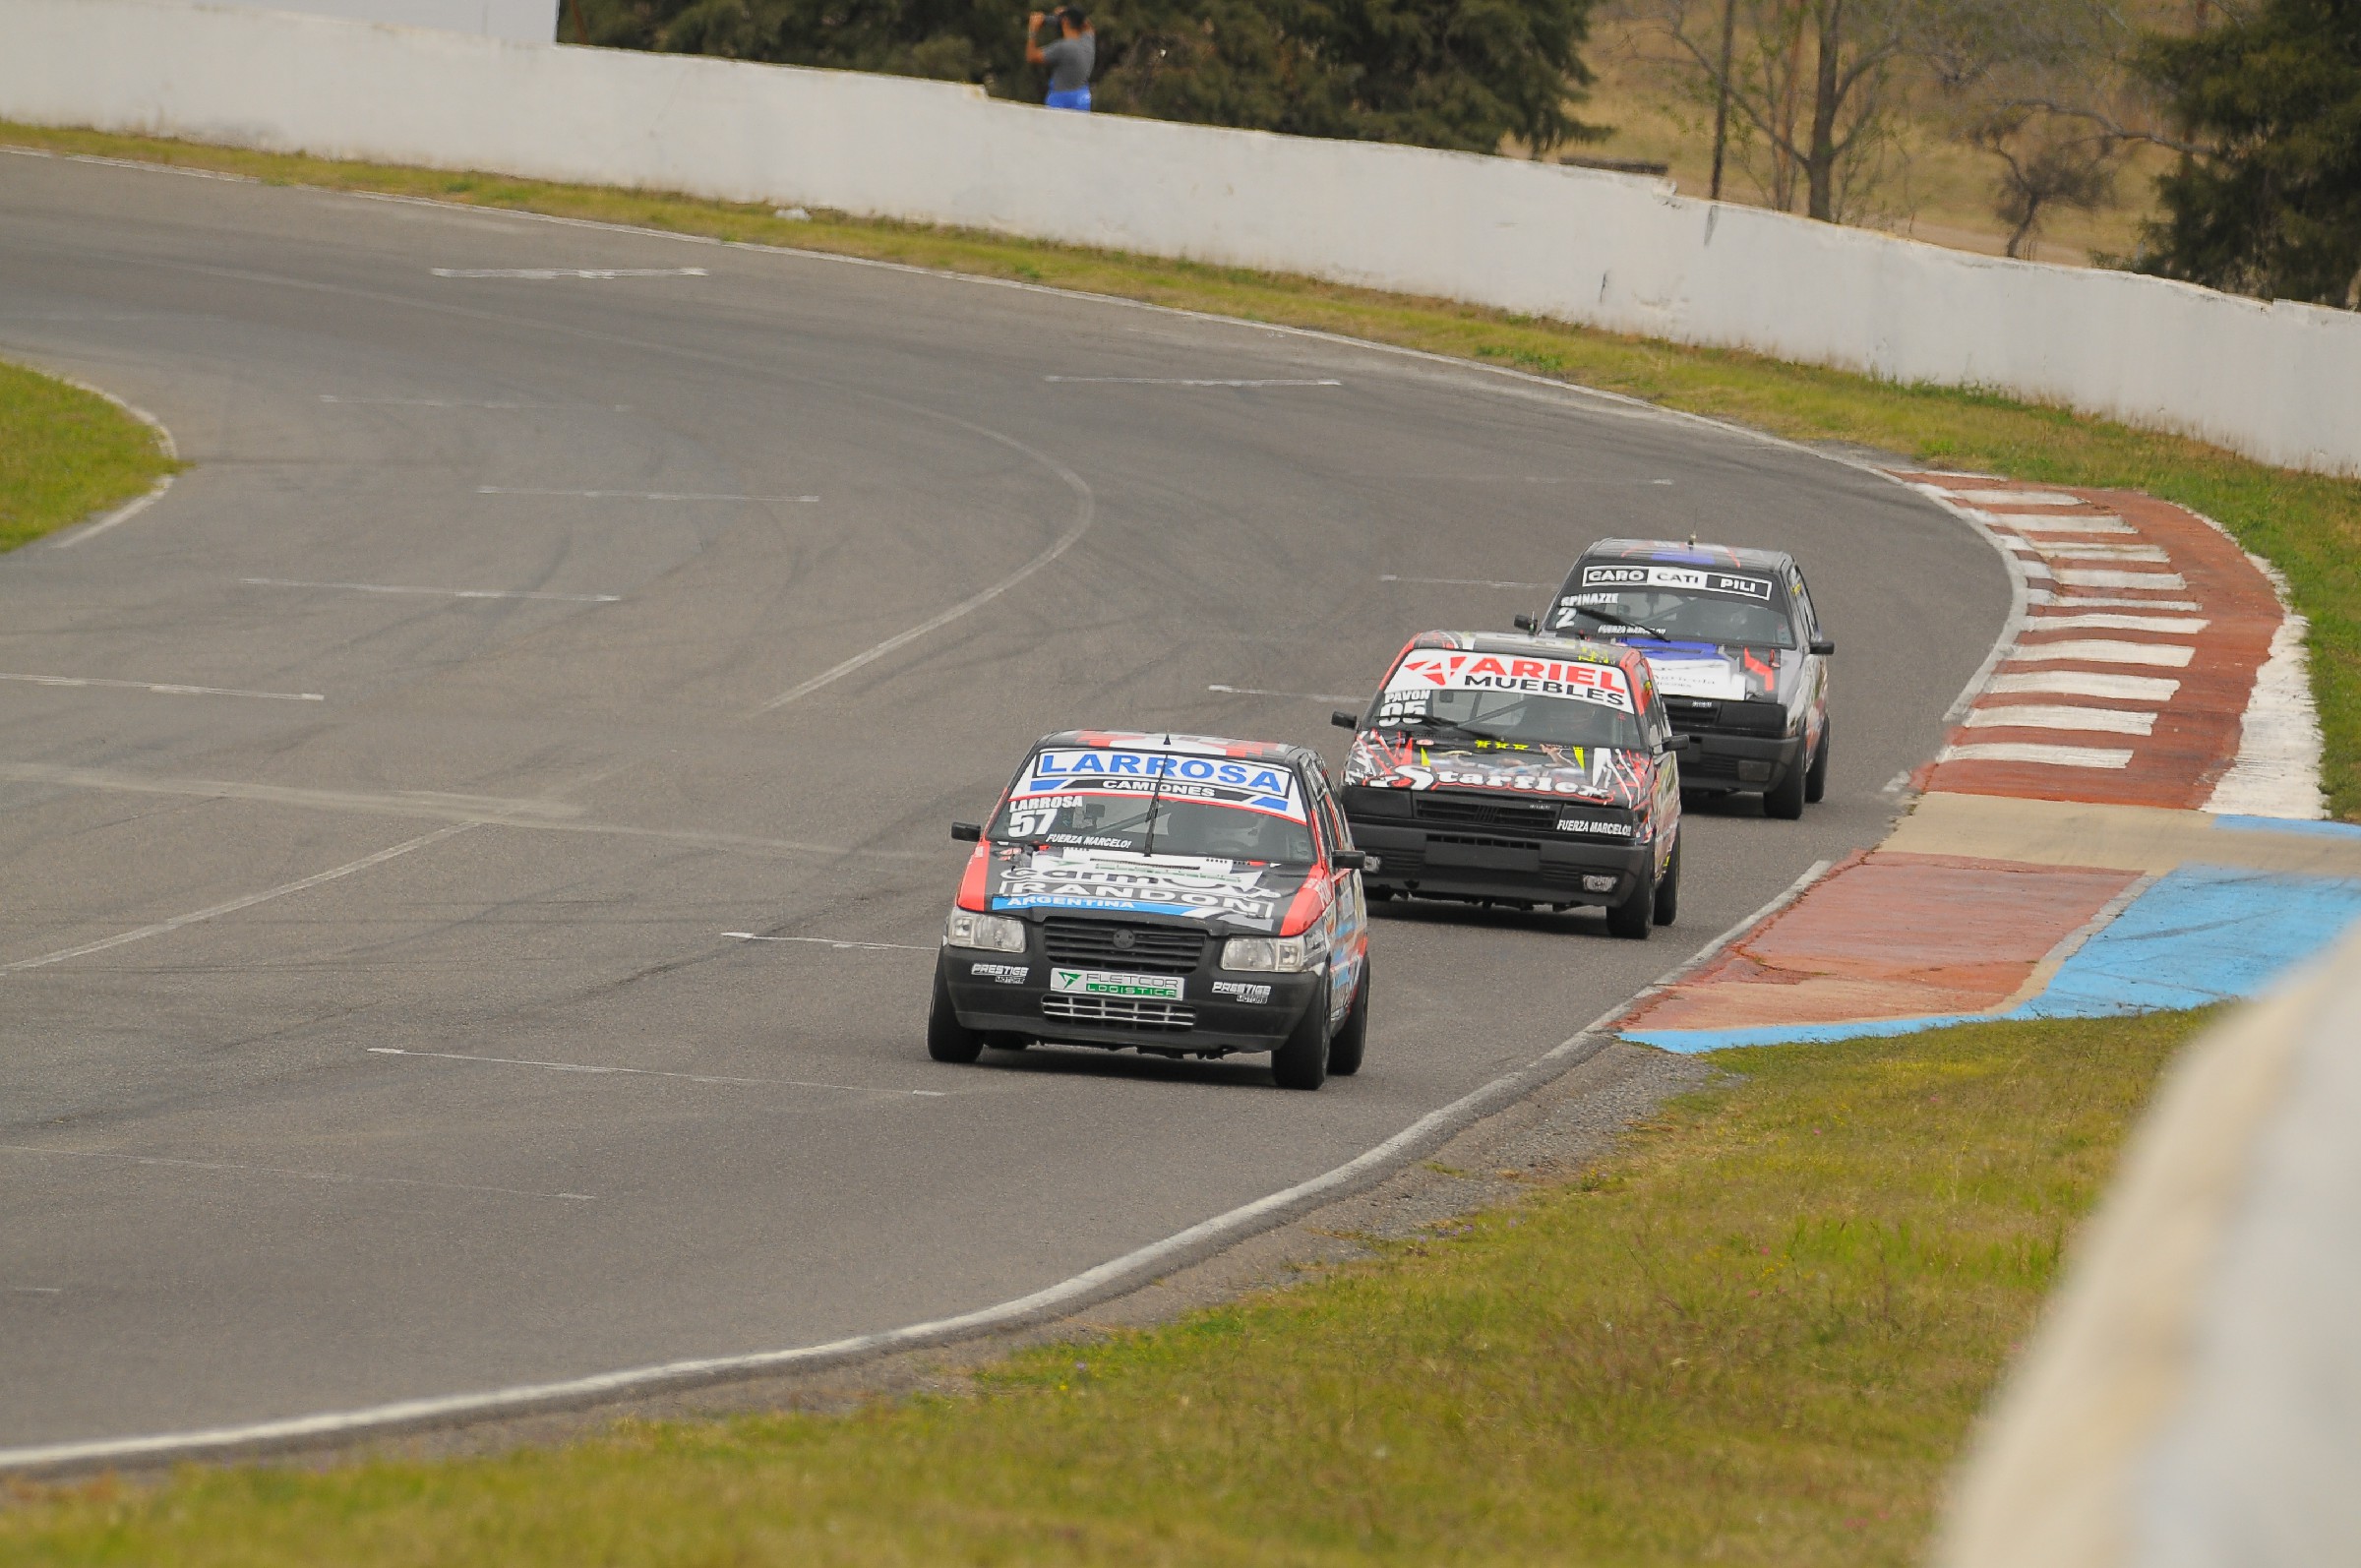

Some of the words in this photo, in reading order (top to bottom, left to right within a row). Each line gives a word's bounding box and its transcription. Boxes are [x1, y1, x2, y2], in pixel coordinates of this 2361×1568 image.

[1588, 570, 1645, 581] CARO
[1657, 573, 1699, 583] CATI
[1720, 578, 1756, 592] PILI
[1555, 606, 1577, 629] 2
[1467, 656, 1625, 694] ARIEL
[1464, 675, 1624, 705] MUEBLES
[1040, 754, 1283, 793] LARROSA
[1102, 779, 1216, 797] CAMIONES
[1009, 795, 1083, 813] LARROSA
[1007, 808, 1058, 837] 57
[1556, 818, 1589, 832] FUERZA
[1046, 833, 1083, 845] FUERZA
[1006, 896, 1135, 909] ARGENTINA
[1011, 881, 1259, 914] RANDON
[971, 963, 1030, 977] PRESTIGE
[1086, 973, 1179, 988] FLETCOR
[1212, 981, 1272, 995] PRESTIGE
[1087, 985, 1177, 996] LOGISTICA
